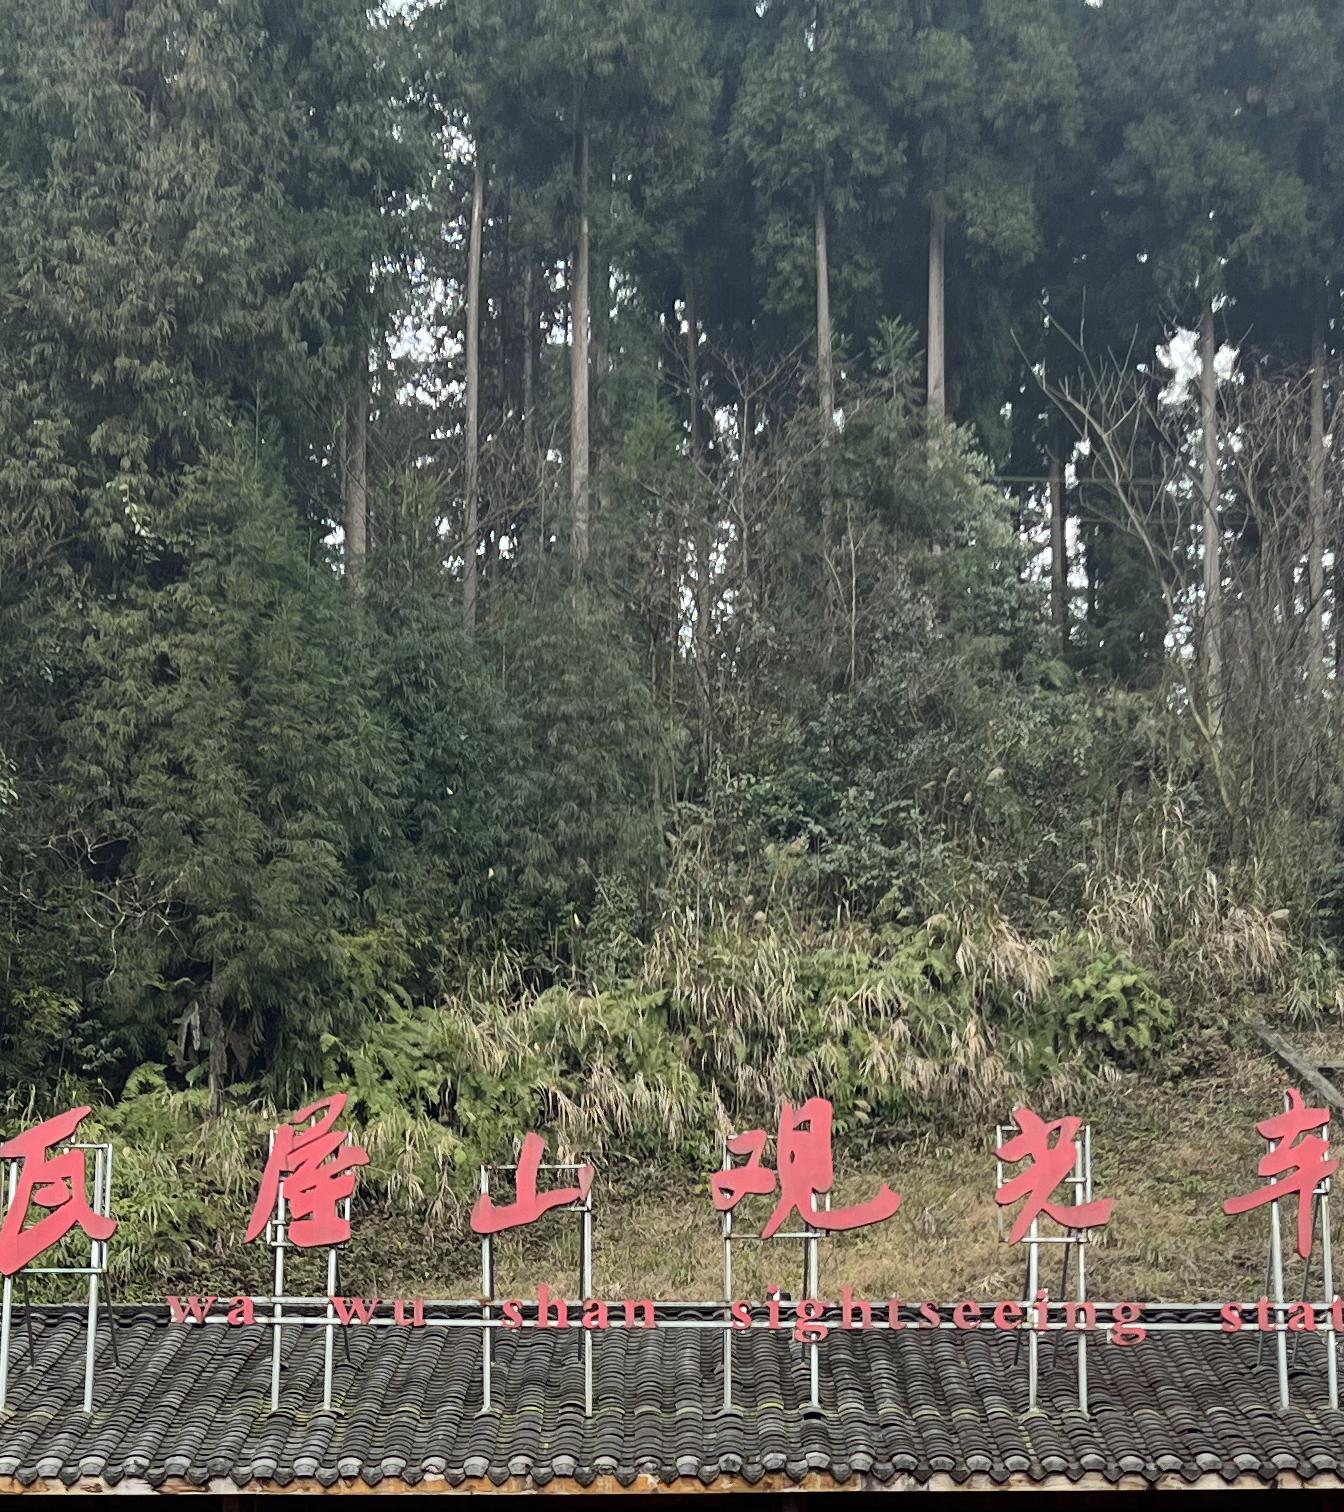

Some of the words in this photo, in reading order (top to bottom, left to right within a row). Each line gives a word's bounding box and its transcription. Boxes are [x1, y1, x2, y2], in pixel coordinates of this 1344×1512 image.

[167, 1294, 255, 1326] wa
[331, 1294, 425, 1326] wu
[501, 1284, 657, 1330] shan
[730, 1285, 1148, 1344] sightseeing
